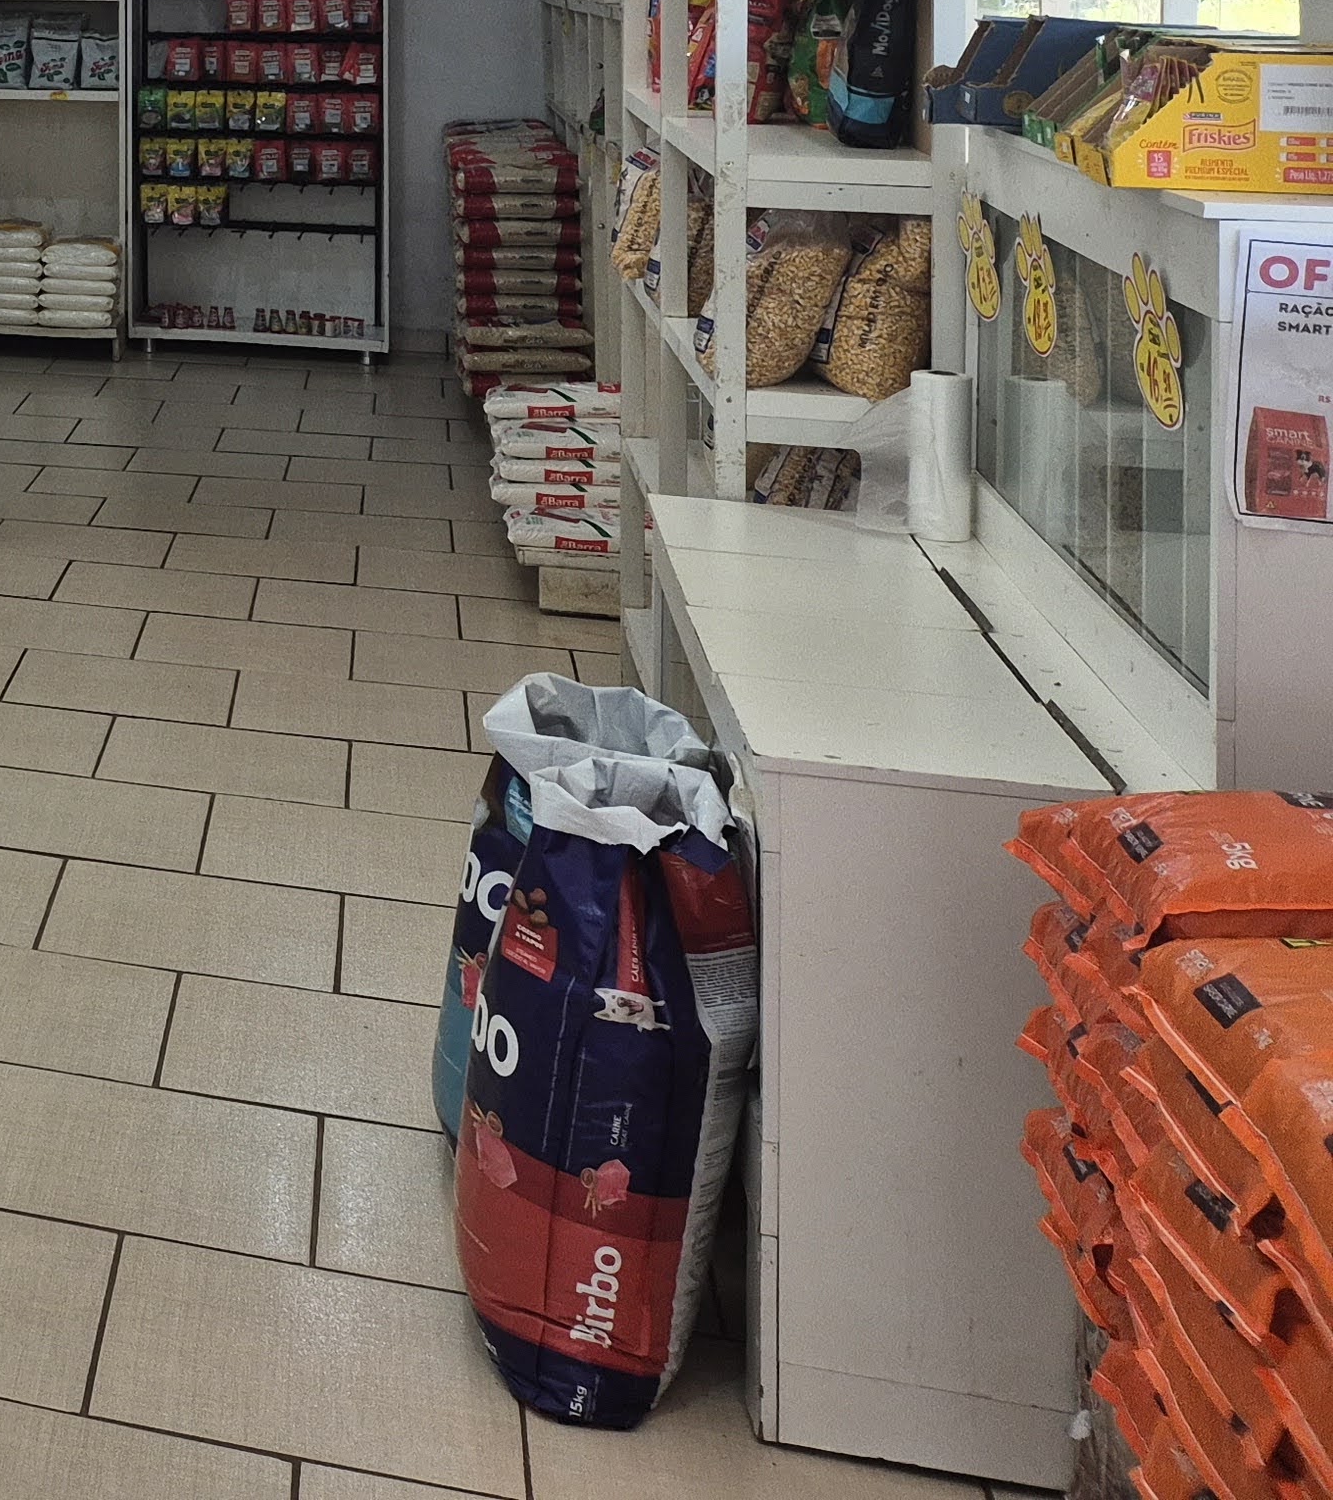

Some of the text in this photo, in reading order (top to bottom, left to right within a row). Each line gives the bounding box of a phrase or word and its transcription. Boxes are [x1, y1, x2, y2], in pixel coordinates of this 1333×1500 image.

[1188, 128, 1251, 146] Friskies
[1153, 153, 1164, 163] 15
[1216, 167, 1249, 176] ESPECIAL
[1259, 256, 1333, 290] OF
[1277, 321, 1332, 335] SMART
[1266, 428, 1309, 440] smart
[1221, 841, 1259, 871] 5kg
[610, 1114, 621, 1146] CARNE
[570, 1245, 622, 1349] Birbo
[569, 1385, 587, 1418] 15kg
